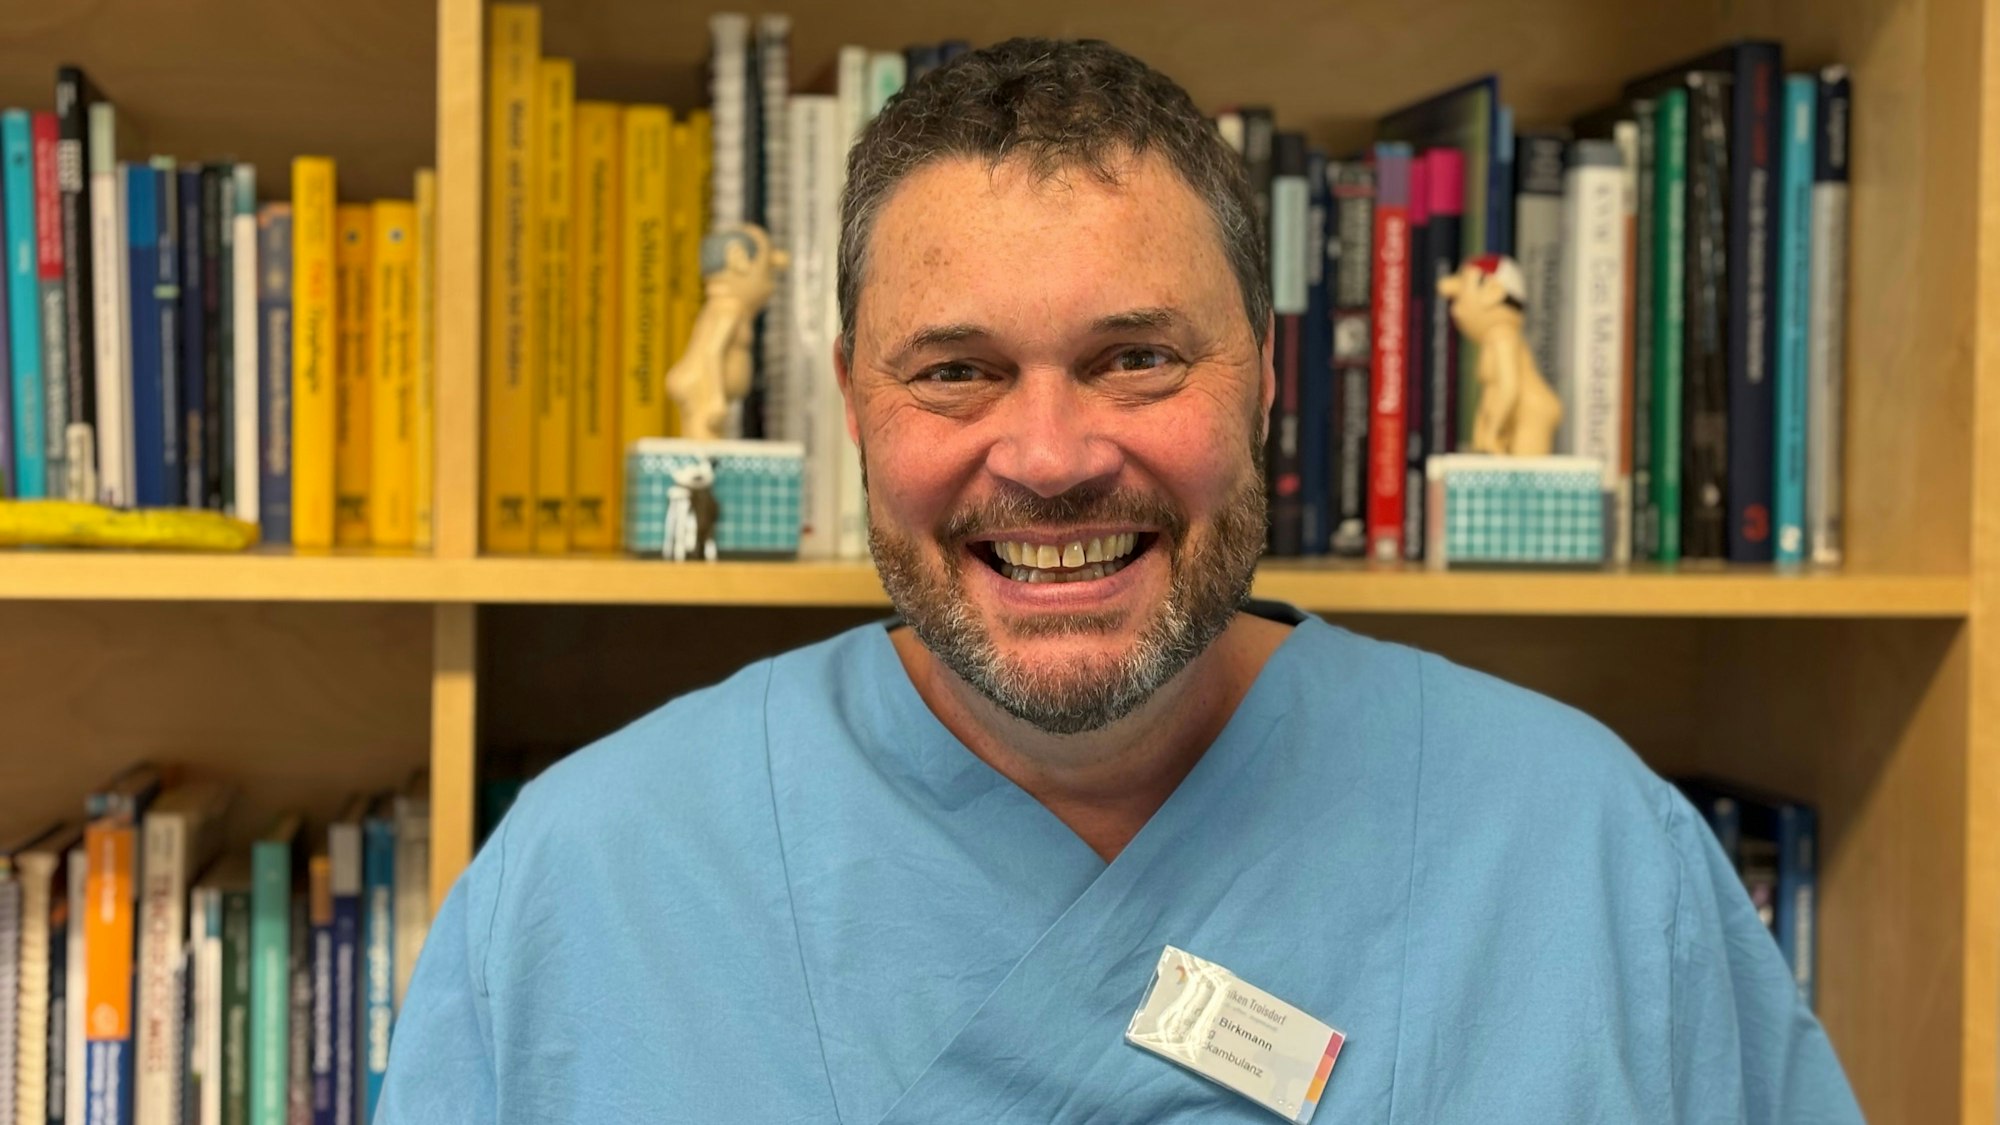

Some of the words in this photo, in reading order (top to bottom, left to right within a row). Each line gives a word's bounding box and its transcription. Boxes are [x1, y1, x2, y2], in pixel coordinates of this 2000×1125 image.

[1380, 215, 1405, 263] Care
[632, 217, 660, 407] Schluckstörungen
[1249, 998, 1287, 1025] Troisdorf
[1218, 1016, 1273, 1052] Birkmann
